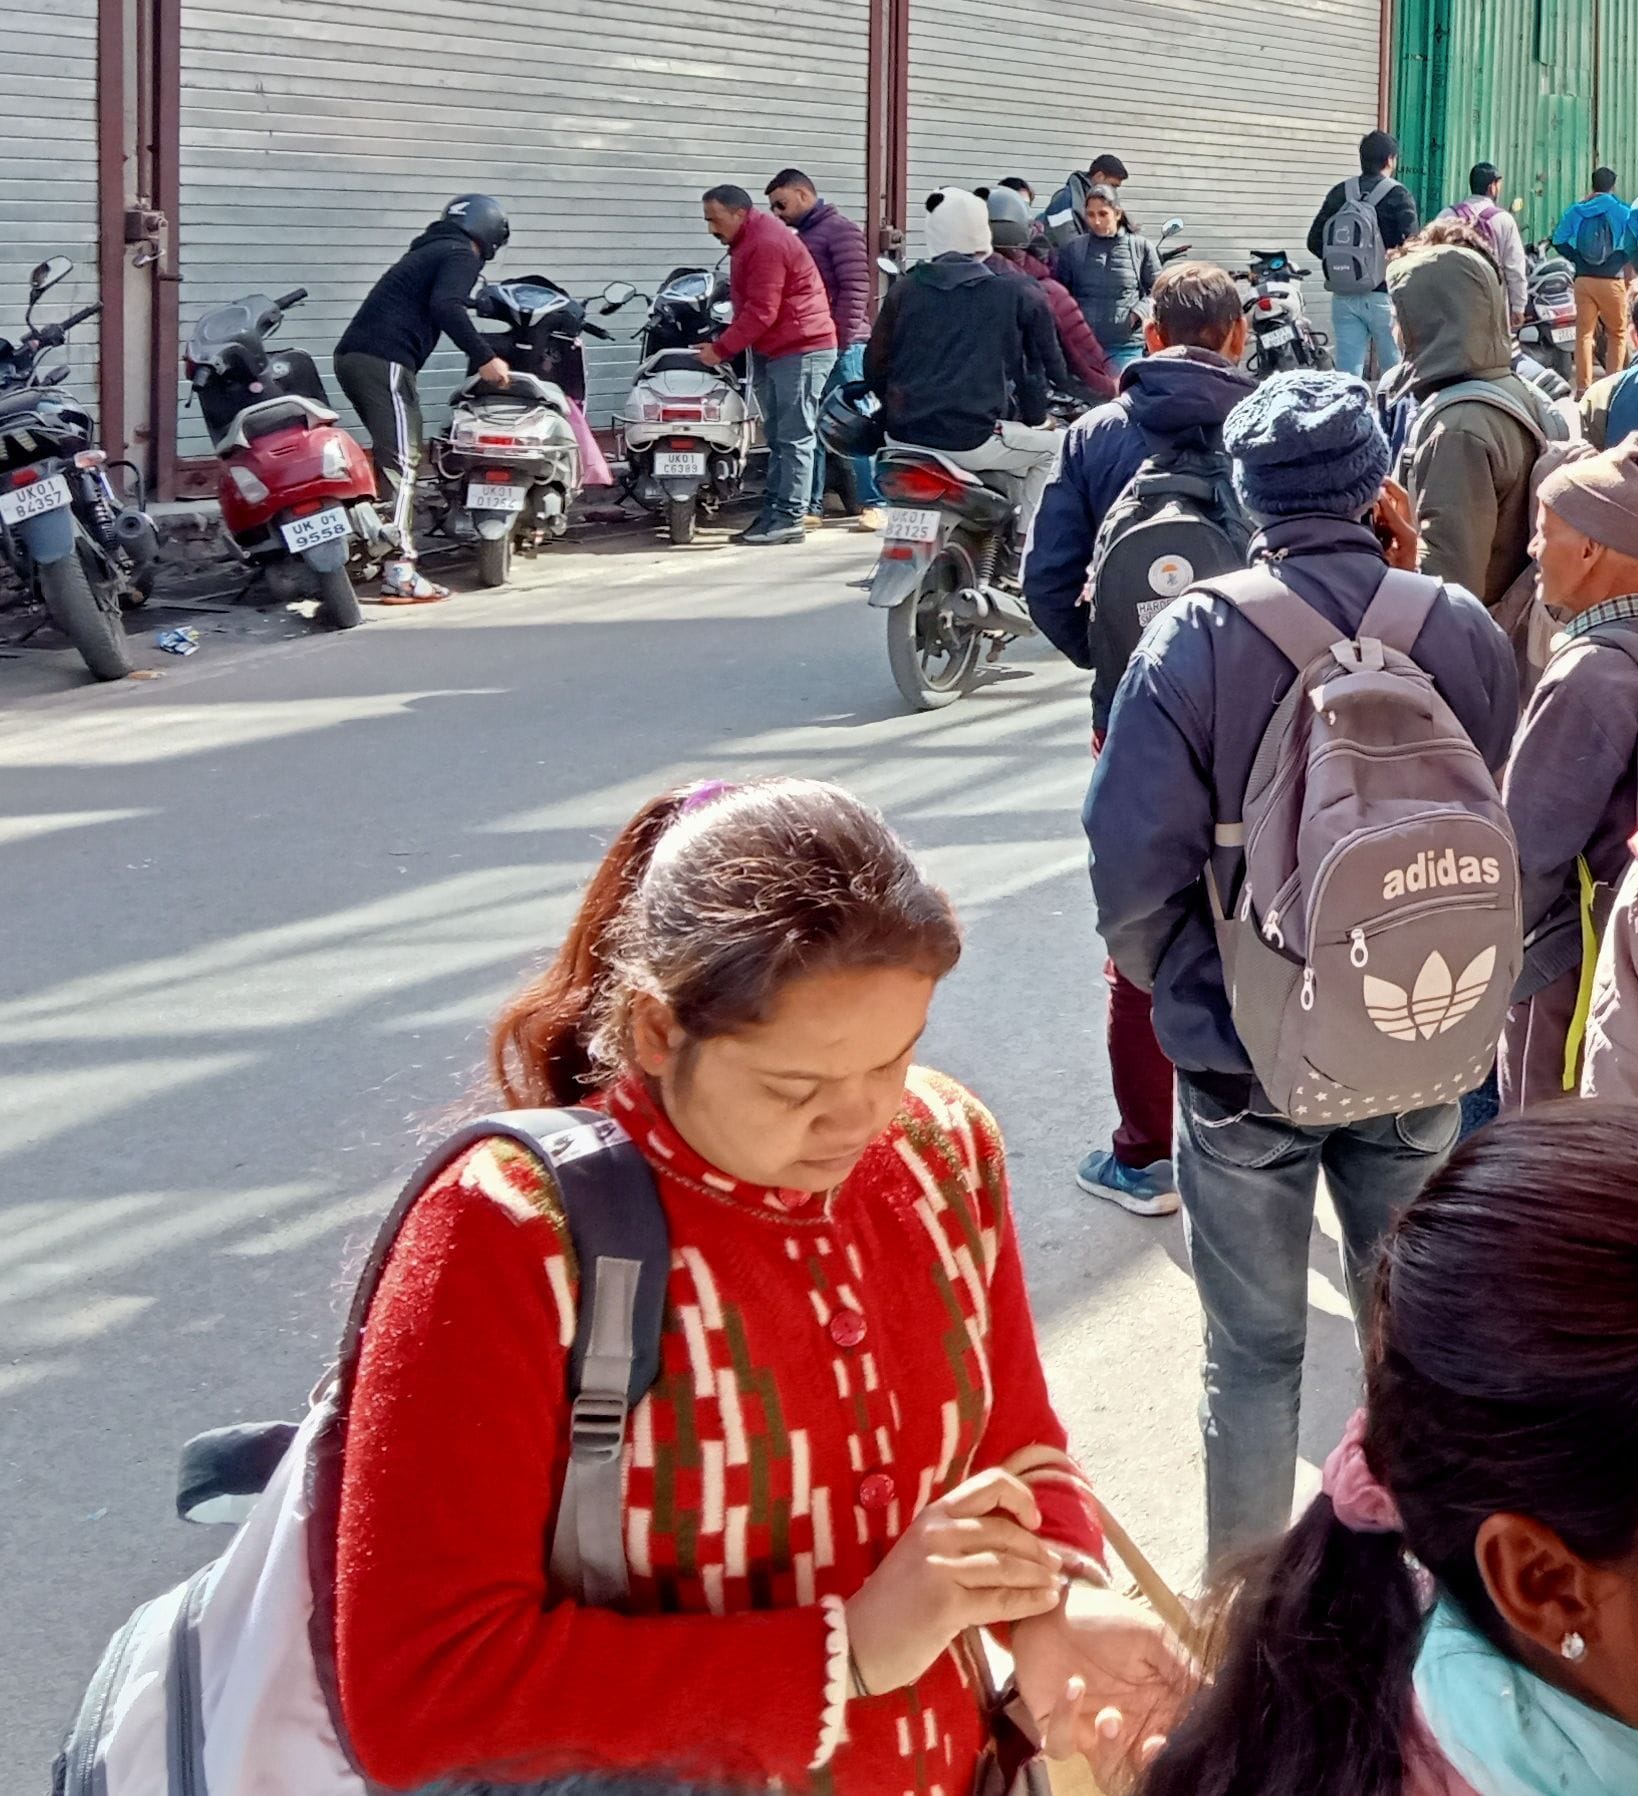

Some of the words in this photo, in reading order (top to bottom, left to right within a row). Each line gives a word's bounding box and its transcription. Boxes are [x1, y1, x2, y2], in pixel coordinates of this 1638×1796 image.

[668, 454, 694, 464] UK01
[16, 480, 55, 503] UK01
[292, 521, 314, 534] UK
[320, 514, 337, 525] 01
[296, 523, 346, 547] 9558
[1382, 848, 1500, 900] adidas
